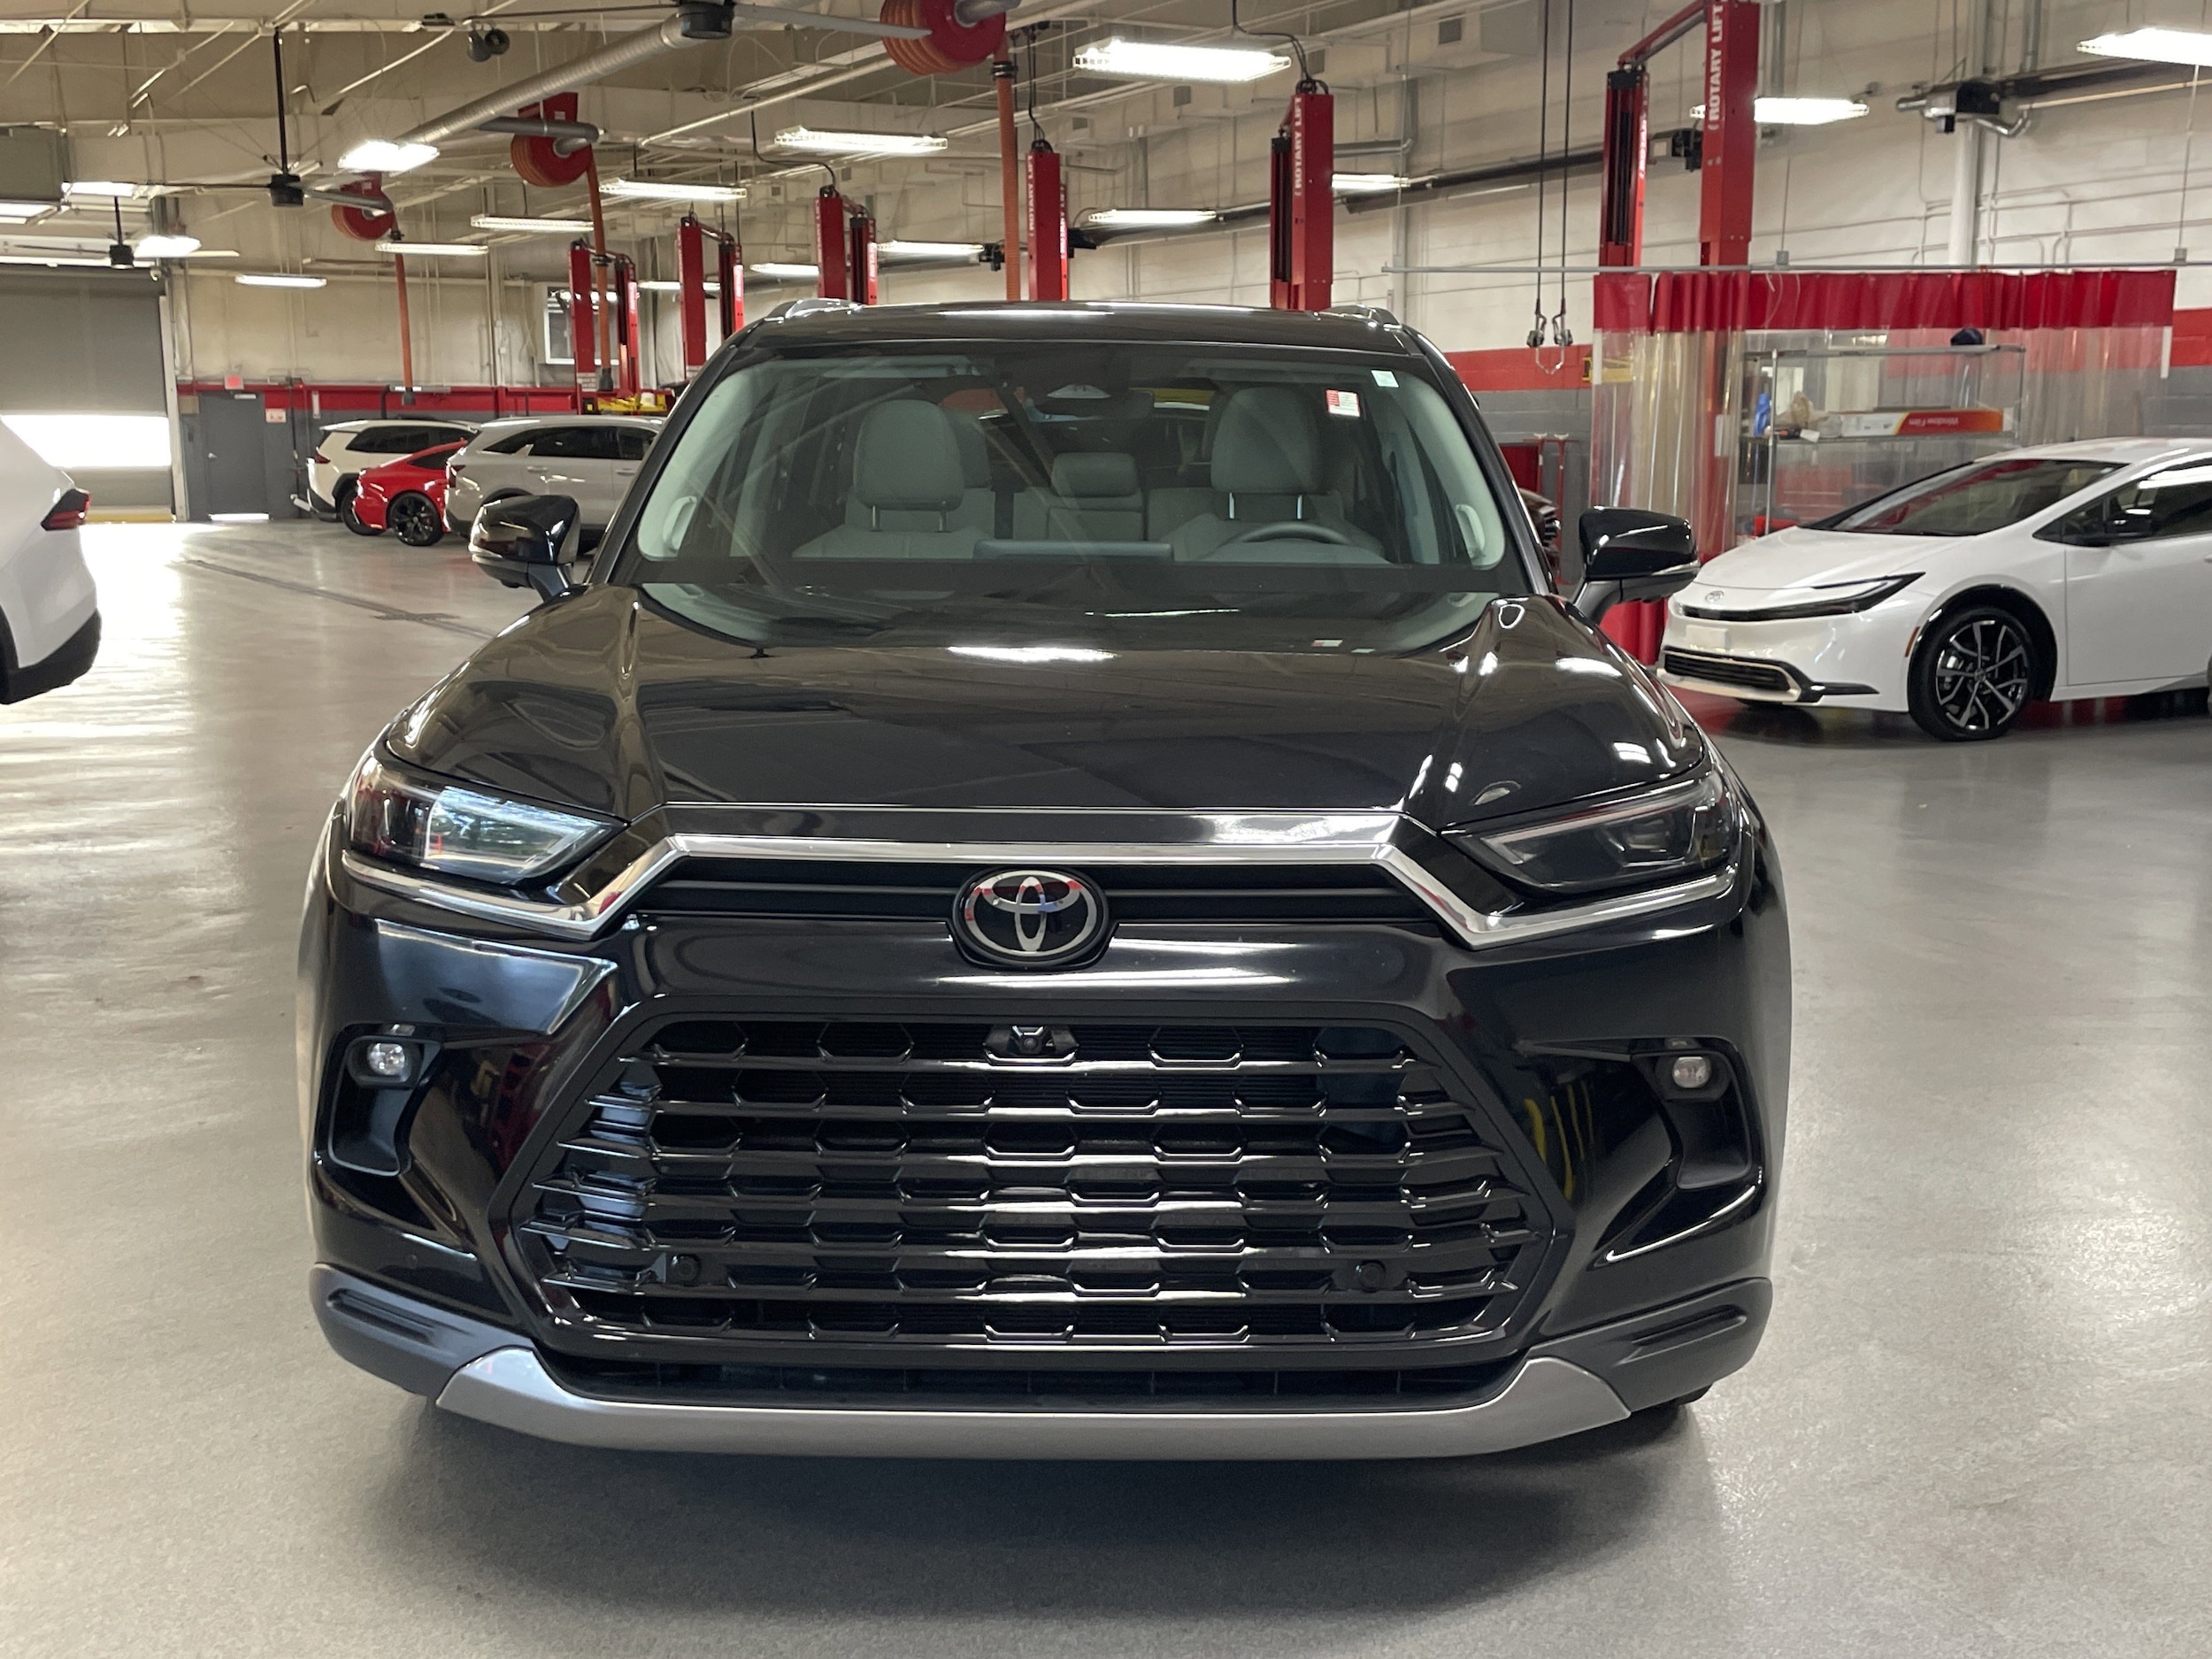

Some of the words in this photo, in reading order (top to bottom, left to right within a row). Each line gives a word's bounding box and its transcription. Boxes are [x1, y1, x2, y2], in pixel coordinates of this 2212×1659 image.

[1711, 4, 1724, 43] LIFT
[1708, 48, 1722, 121] ROTARY
[1294, 96, 1302, 127] LIFT
[1294, 130, 1302, 189] ROTARY
